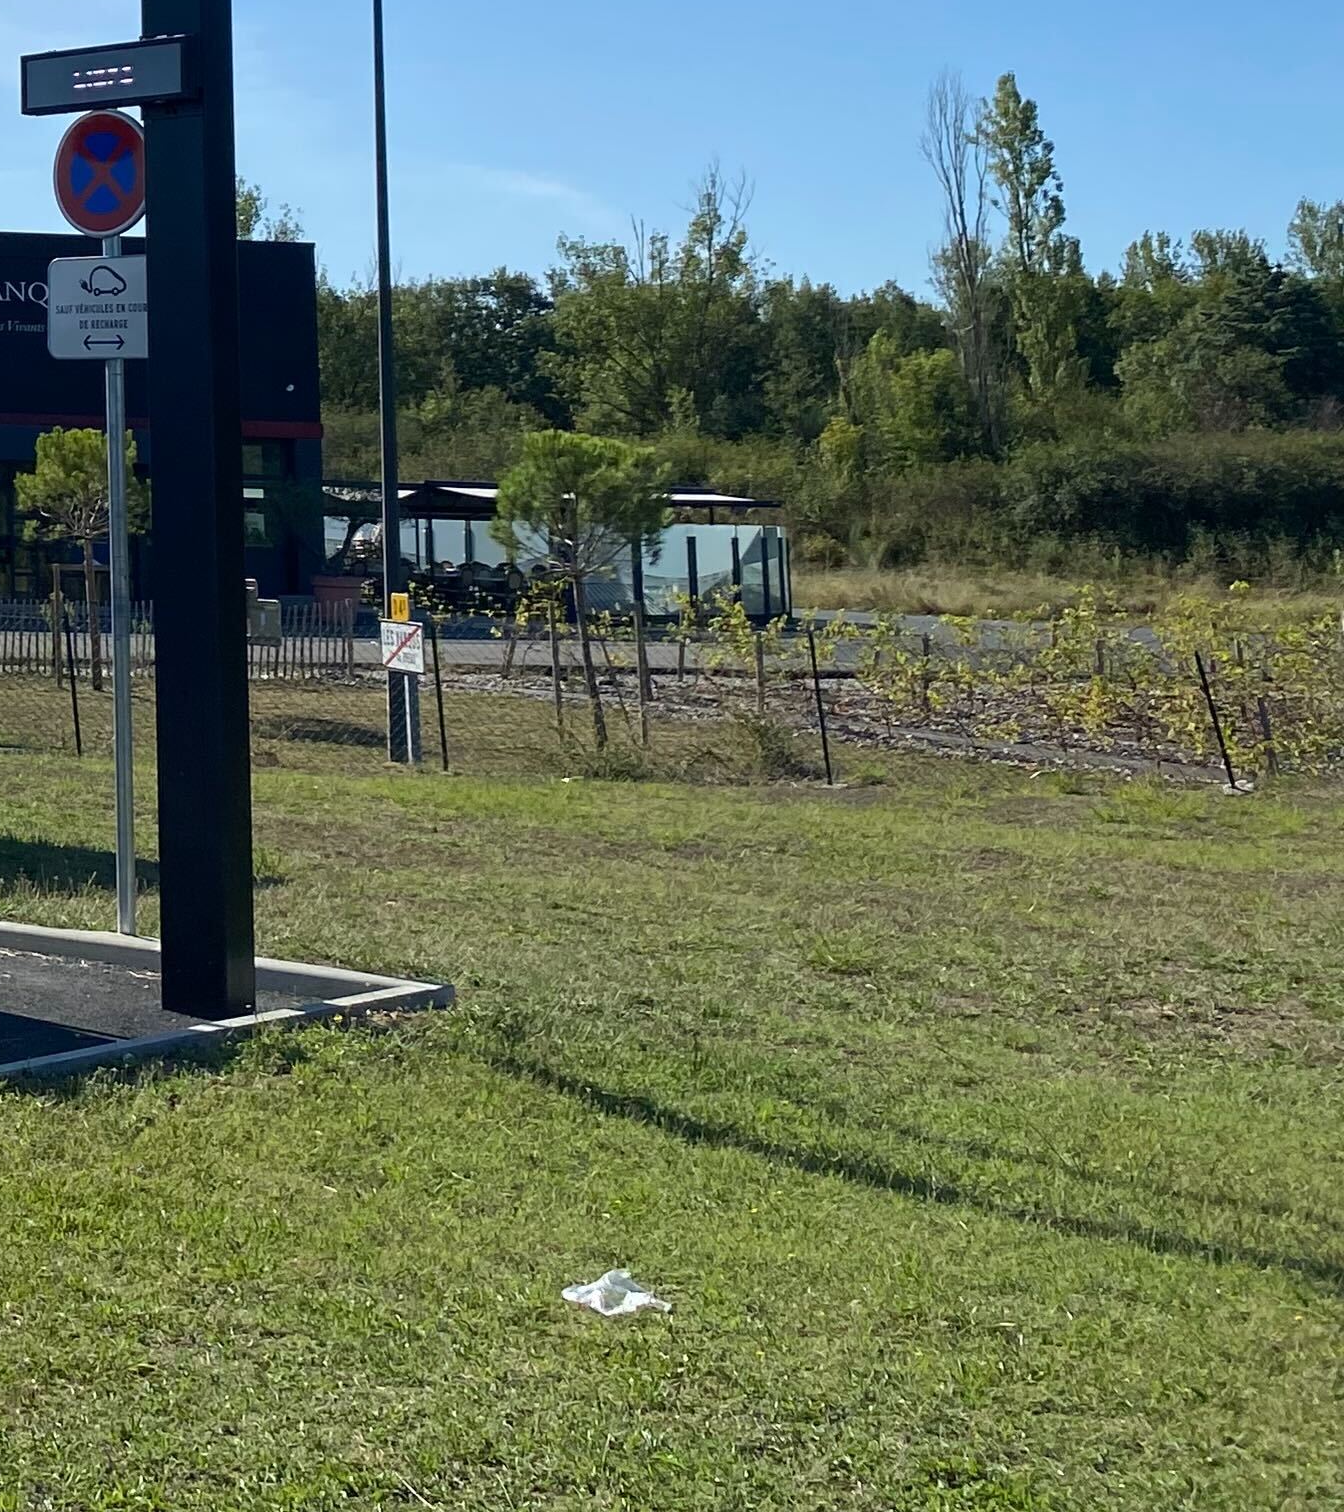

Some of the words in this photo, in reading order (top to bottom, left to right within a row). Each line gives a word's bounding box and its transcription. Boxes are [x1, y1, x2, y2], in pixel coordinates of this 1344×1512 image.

[55, 304, 73, 314] SAUF
[75, 302, 114, 314] VÉHICULES
[116, 303, 126, 313] EN
[7, 320, 45, 333] Vivants
[79, 319, 88, 329] DE
[91, 319, 128, 329] RECHARGE
